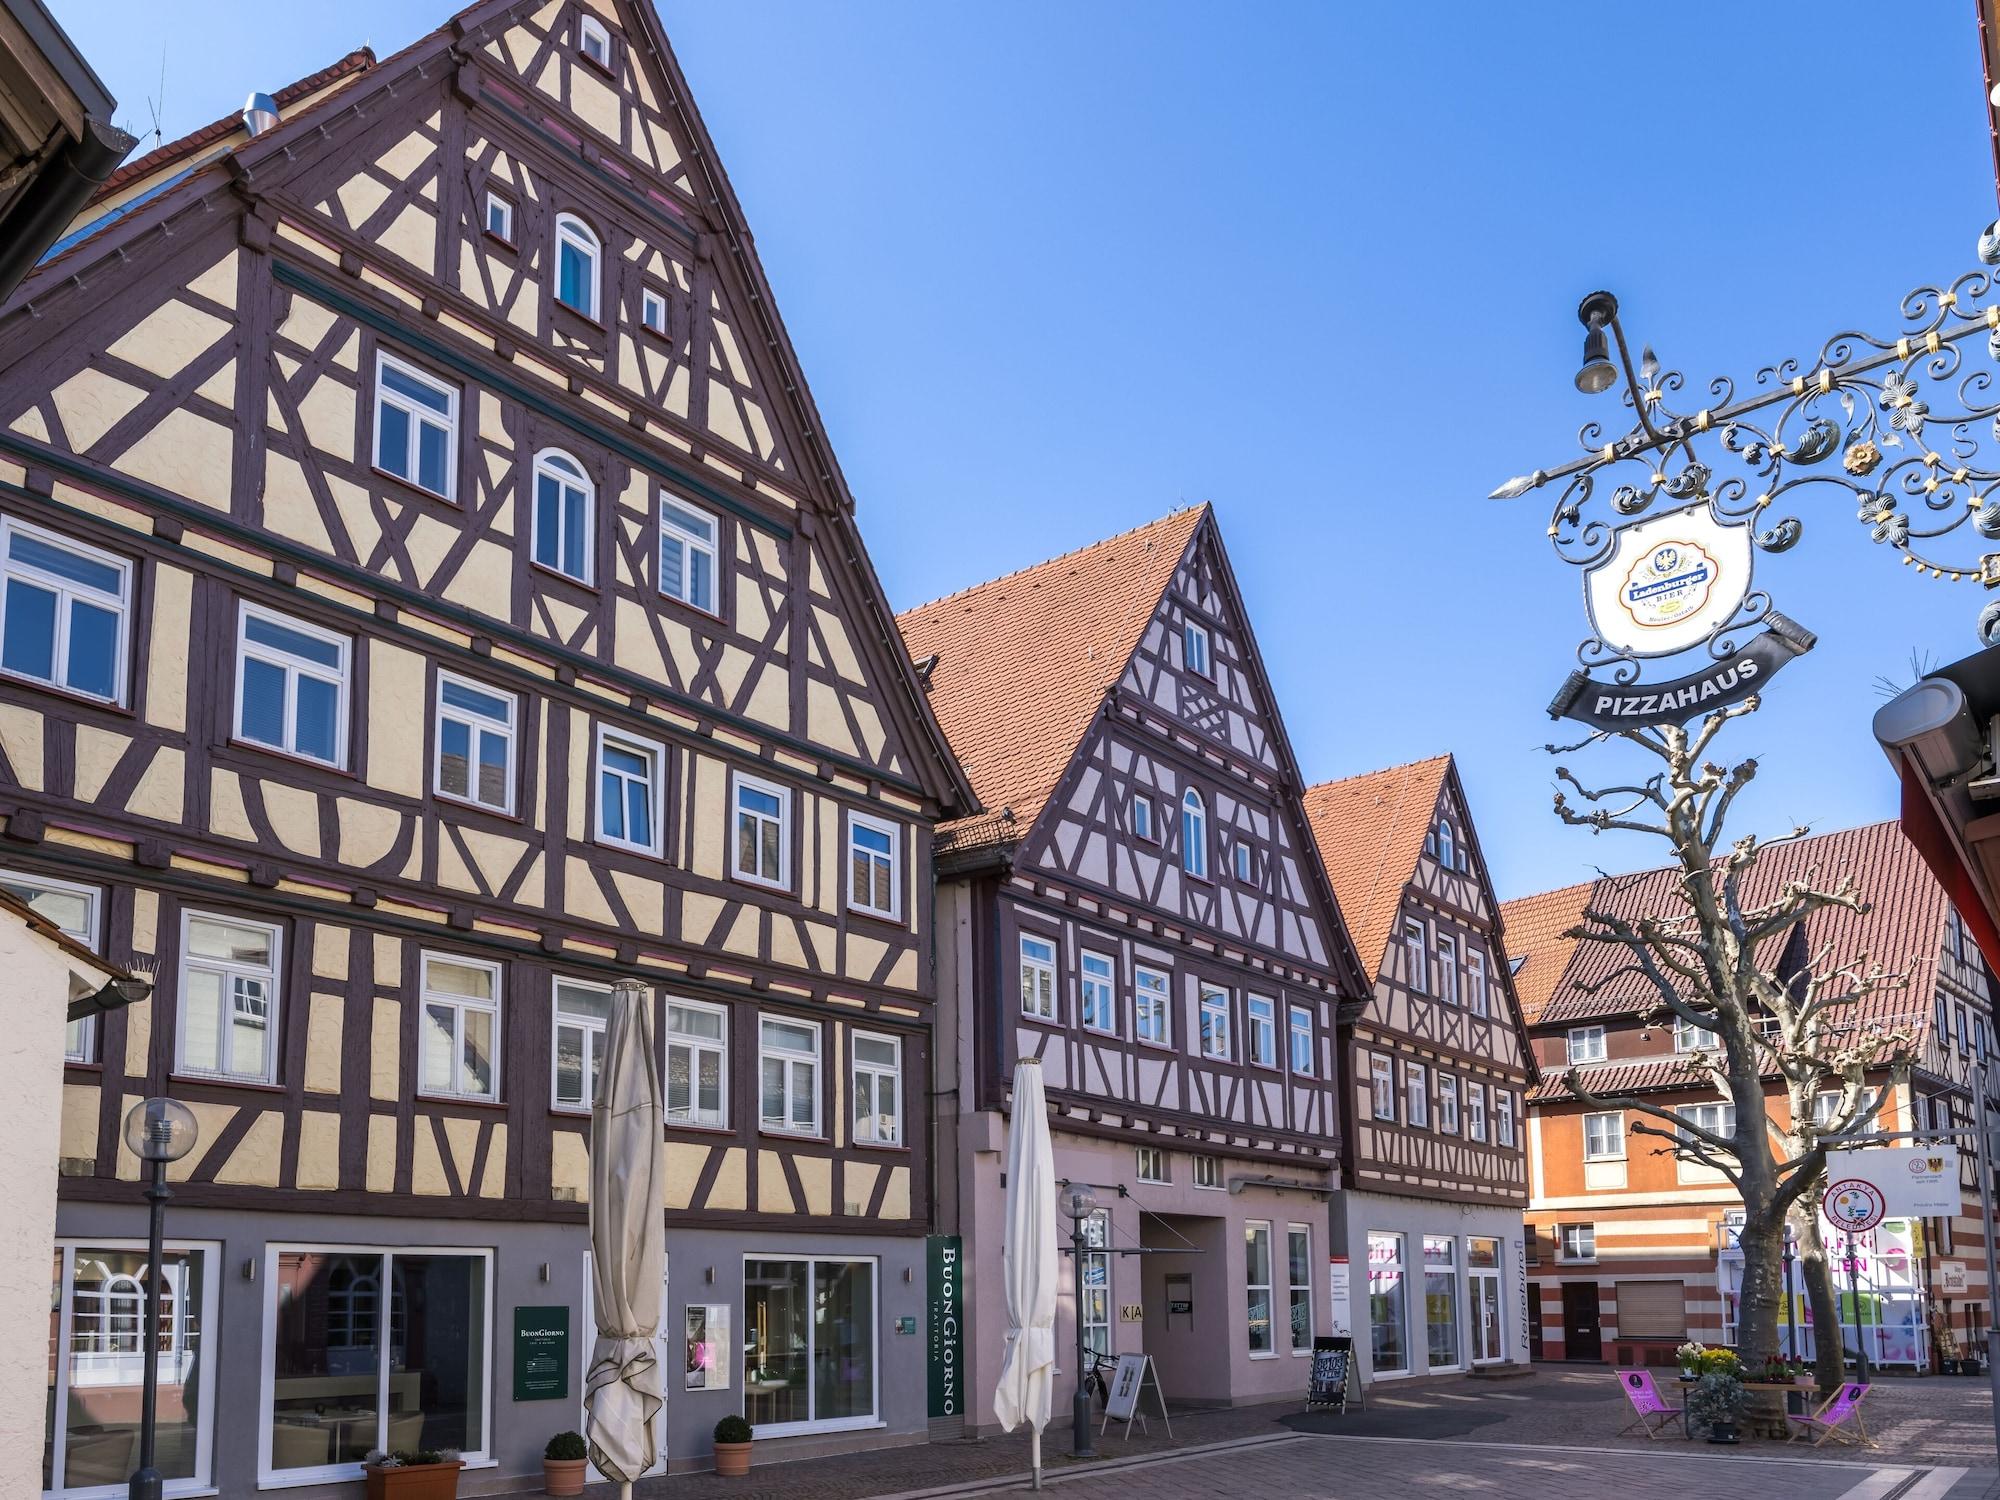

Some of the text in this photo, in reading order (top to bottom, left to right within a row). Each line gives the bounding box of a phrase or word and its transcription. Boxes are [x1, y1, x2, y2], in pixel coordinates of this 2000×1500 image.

[1632, 572, 1705, 600] Ladenburger
[1656, 589, 1684, 602] BIER
[1594, 658, 1759, 716] PIZZAHAUS
[1831, 1182, 1875, 1198] ANTAKYA
[1517, 1250, 1529, 1350] Reisebüro
